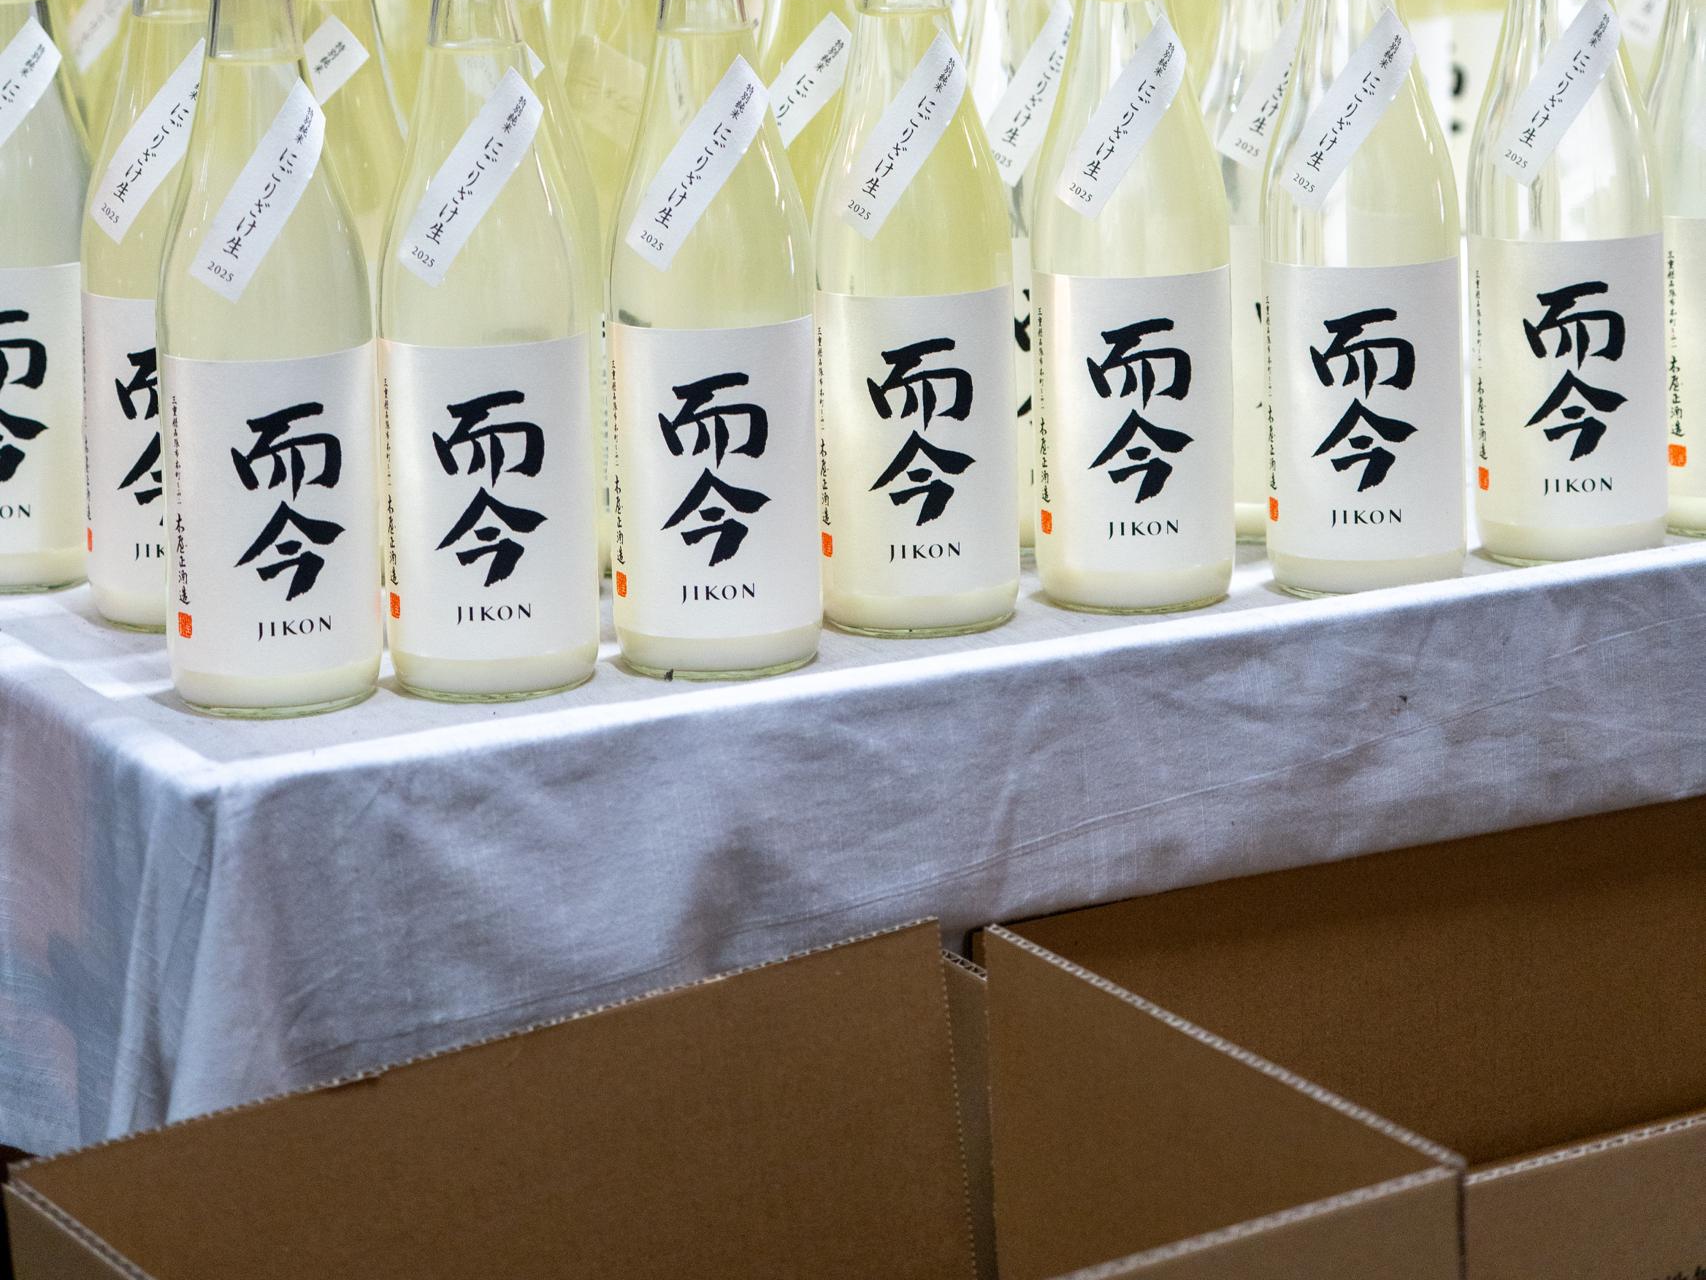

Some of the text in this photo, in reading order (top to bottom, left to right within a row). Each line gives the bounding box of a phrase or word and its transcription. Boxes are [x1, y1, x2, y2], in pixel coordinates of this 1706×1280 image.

[1519, 49, 1591, 148] にごりざけ生
[1083, 79, 1156, 182] にごりざけ生
[1306, 71, 1381, 172] にごりざけ生
[113, 102, 190, 204] にごりざけ生
[861, 95, 936, 199] にごりざけ生
[1504, 148, 1528, 169] 2025
[654, 122, 732, 229] にごりざけ生
[1292, 172, 1316, 194] 2025
[425, 136, 504, 245] にごりざけ生
[1069, 182, 1093, 203] 2025
[100, 202, 121, 224] 2025
[223, 147, 298, 259] にごりざけ生
[847, 199, 872, 221] 2025
[640, 229, 664, 252] 2025
[411, 245, 436, 268] 2025
[207, 260, 234, 283] 2025
[1523, 280, 1628, 462] 而今
[1087, 317, 1195, 504] 而今
[1310, 307, 1419, 493] 而今
[867, 337, 976, 527] 而今
[658, 371, 772, 567] 而今
[433, 390, 548, 588] 而今
[1545, 477, 1612, 495] JIKON
[230, 401, 346, 602] 而今
[1109, 519, 1179, 539] JIKON
[1332, 509, 1402, 528] JIKON
[135, 543, 165, 560] JIK
[890, 542, 961, 562] JIKON
[682, 583, 756, 604] JIKON
[457, 603, 532, 625] JIKON
[258, 617, 332, 641] JIKON
